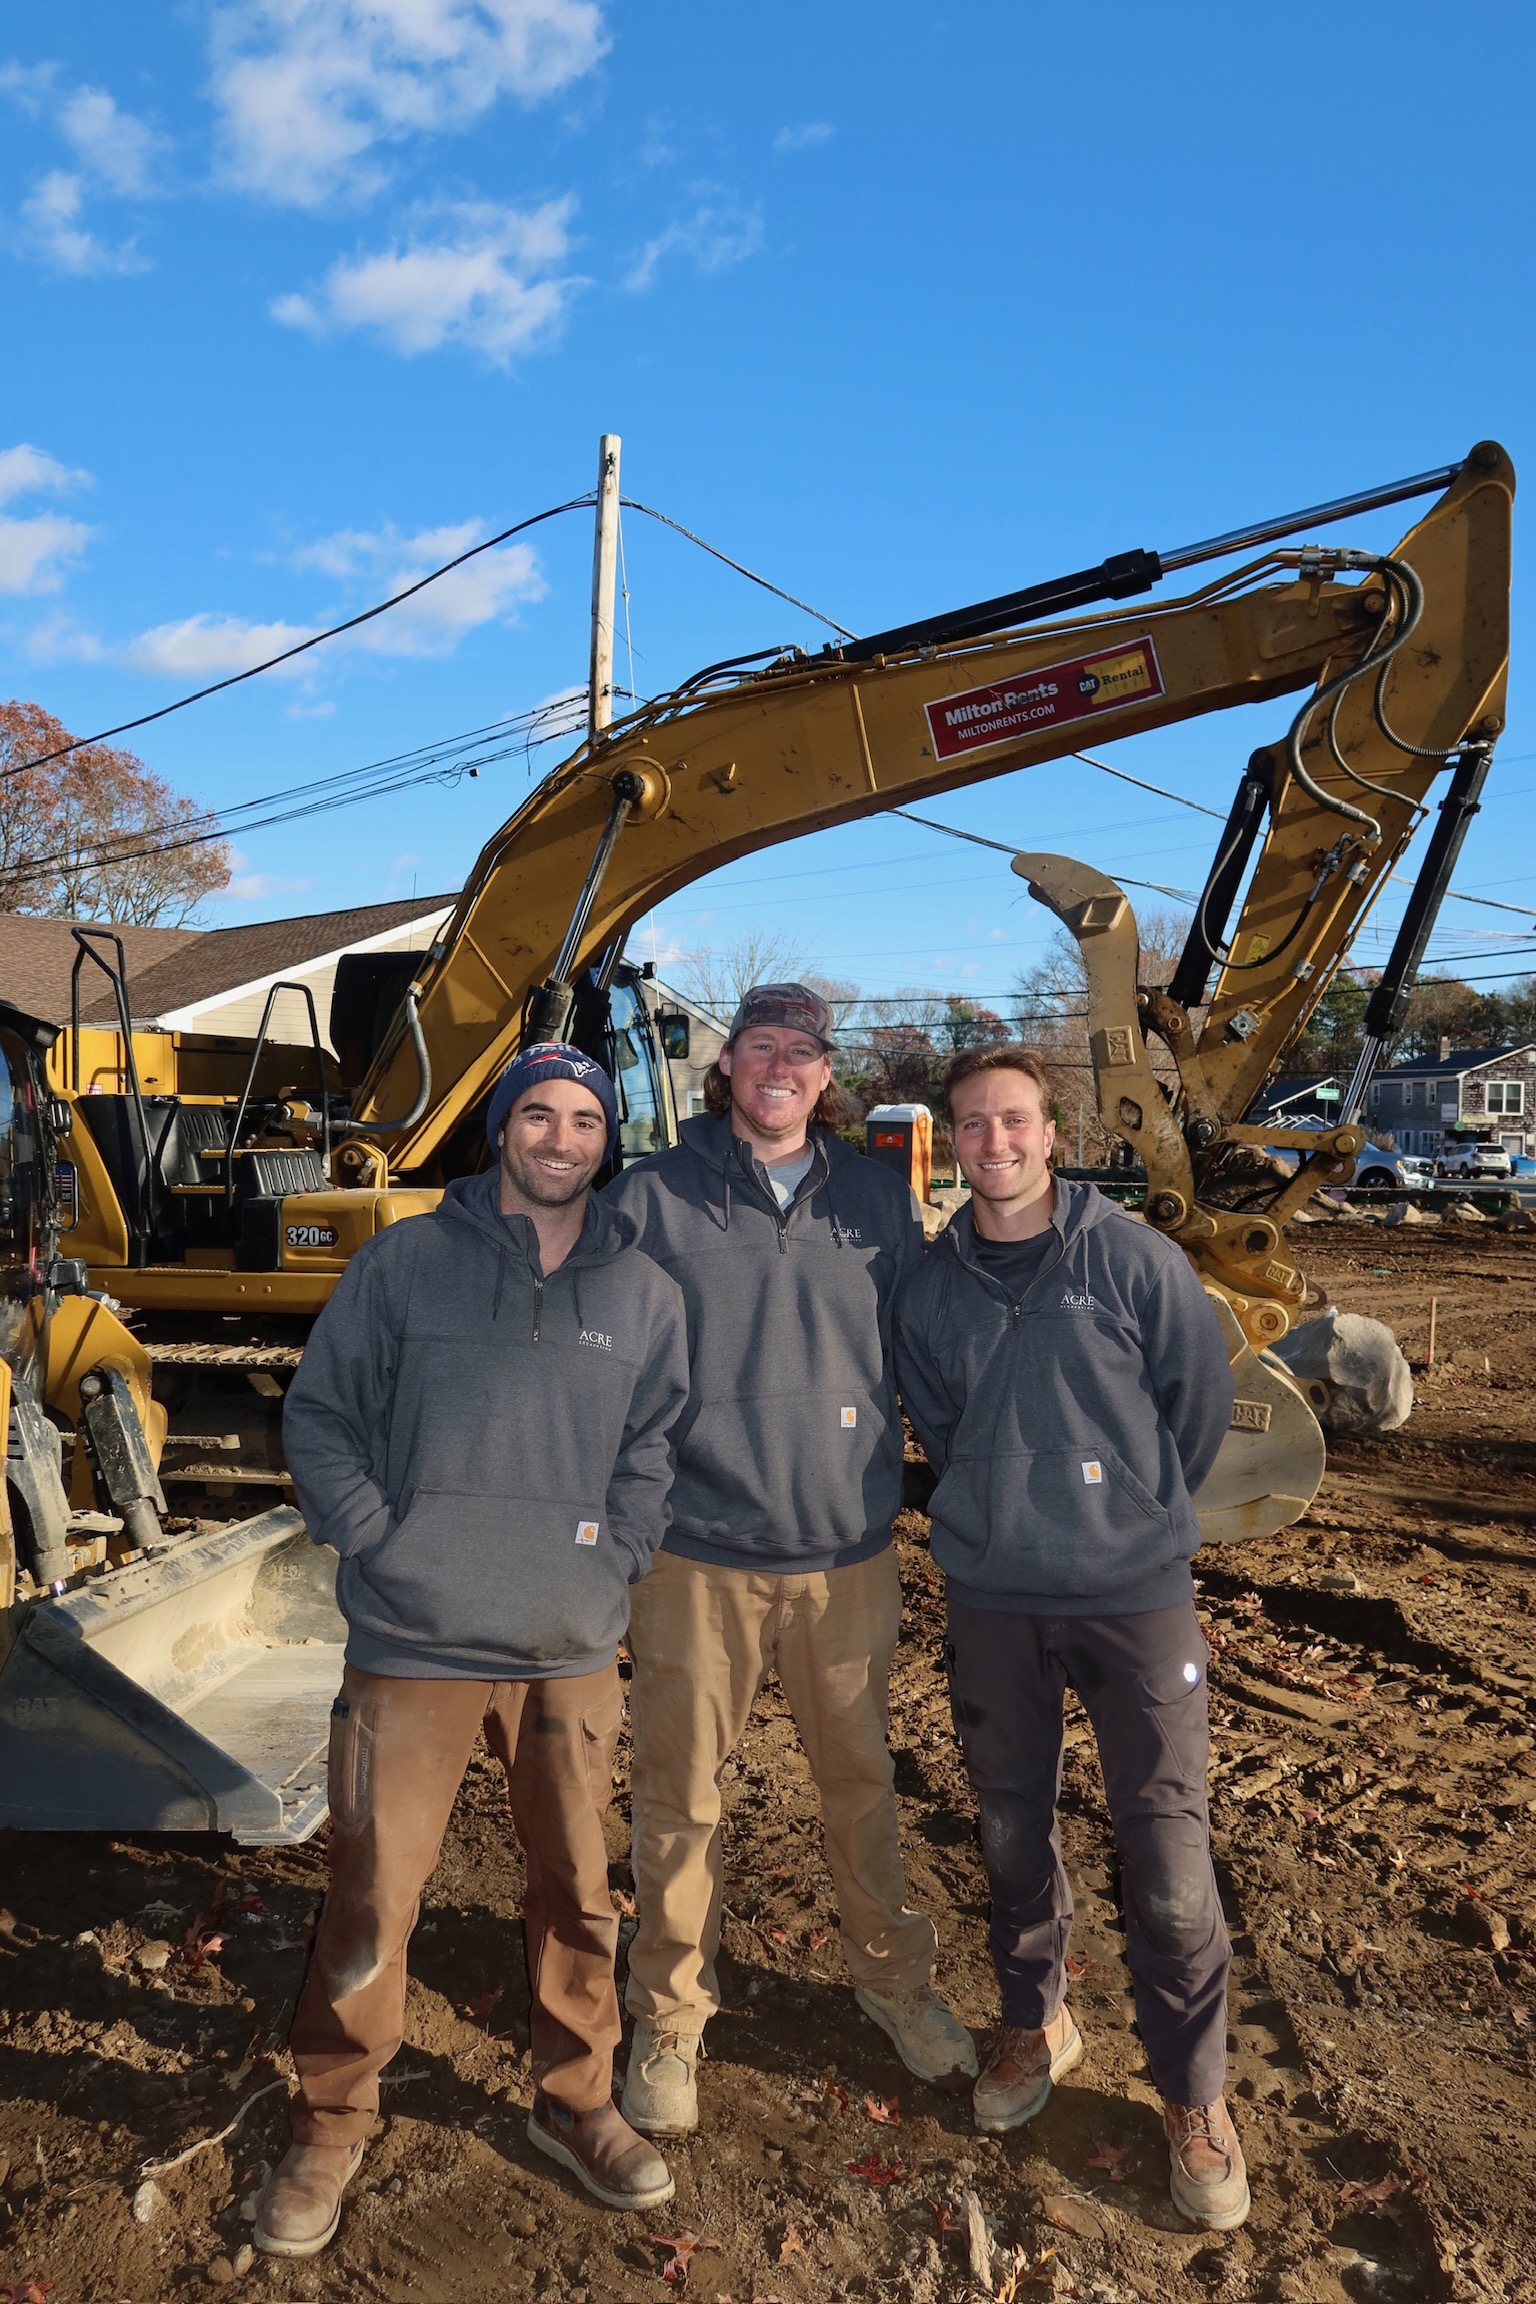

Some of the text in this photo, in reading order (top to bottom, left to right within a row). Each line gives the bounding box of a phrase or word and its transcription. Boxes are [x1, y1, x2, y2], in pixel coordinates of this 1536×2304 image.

[1079, 665, 1145, 692] CAT Rental
[957, 703, 1055, 740] MILTONRENTS.COM
[286, 1226, 333, 1246] 320 GC
[830, 1227, 862, 1238] ACRE
[1061, 1294, 1095, 1306] ACRE
[579, 1330, 612, 1347] ACRE
